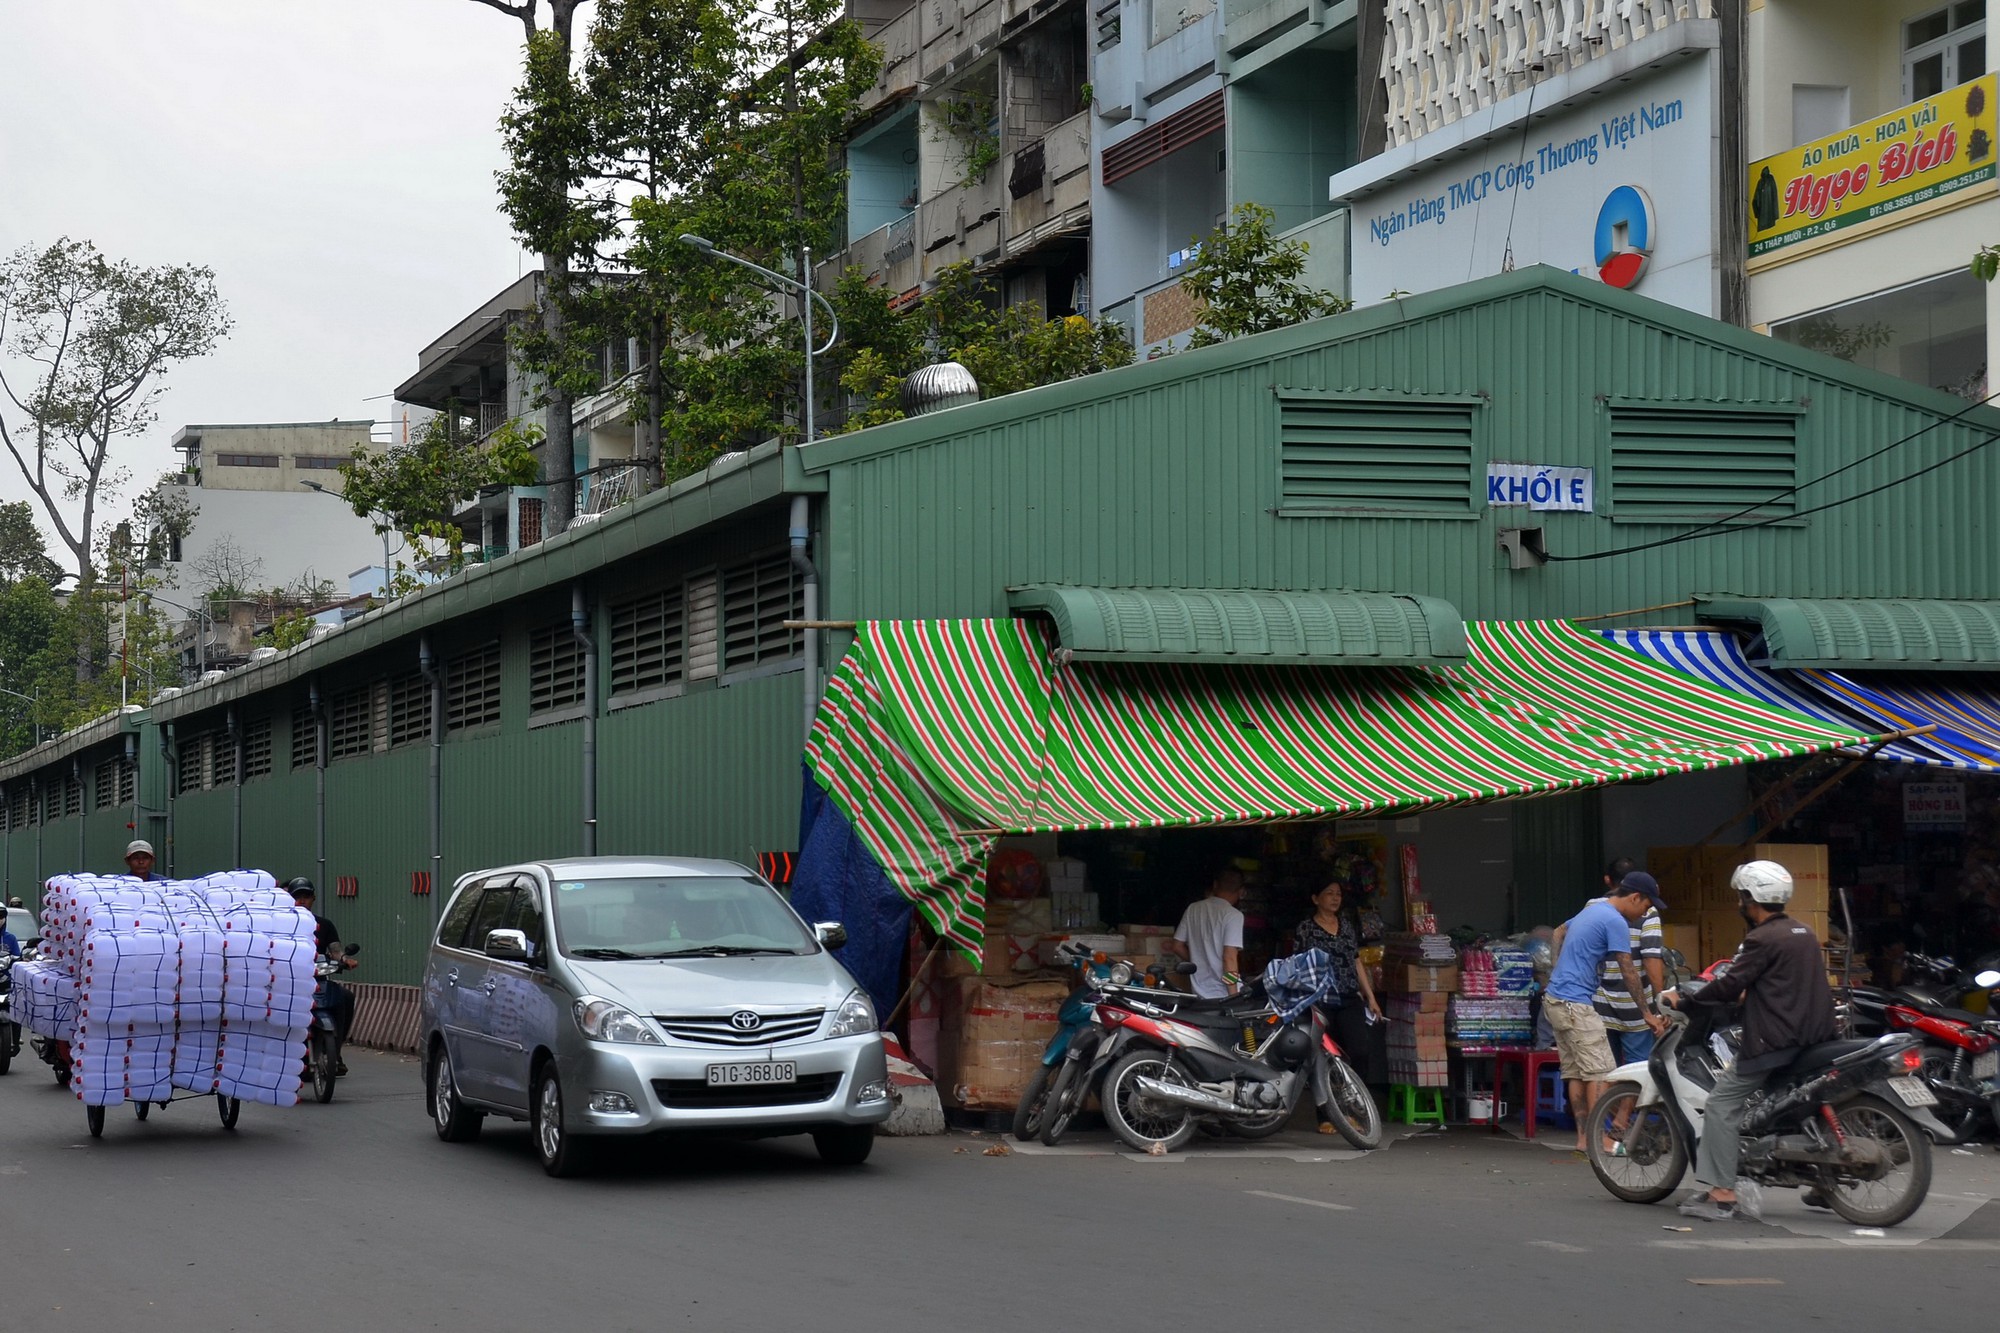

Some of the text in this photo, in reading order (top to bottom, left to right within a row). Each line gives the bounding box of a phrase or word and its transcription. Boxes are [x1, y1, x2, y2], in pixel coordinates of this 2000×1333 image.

[1802, 143, 1822, 168] ÁO
[1827, 134, 1860, 161] MƯA
[1876, 118, 1907, 143] HOA
[1912, 102, 1937, 128] VẢI
[1370, 99, 1683, 247] Ngân Hàng TMCP Công Thương Việt Nam
[1782, 122, 1958, 218] Ngọc Bích
[1754, 243, 1763, 252] 24
[1488, 469, 1584, 504] KHỐI E
[710, 1064, 793, 1083] 51G-368.08
